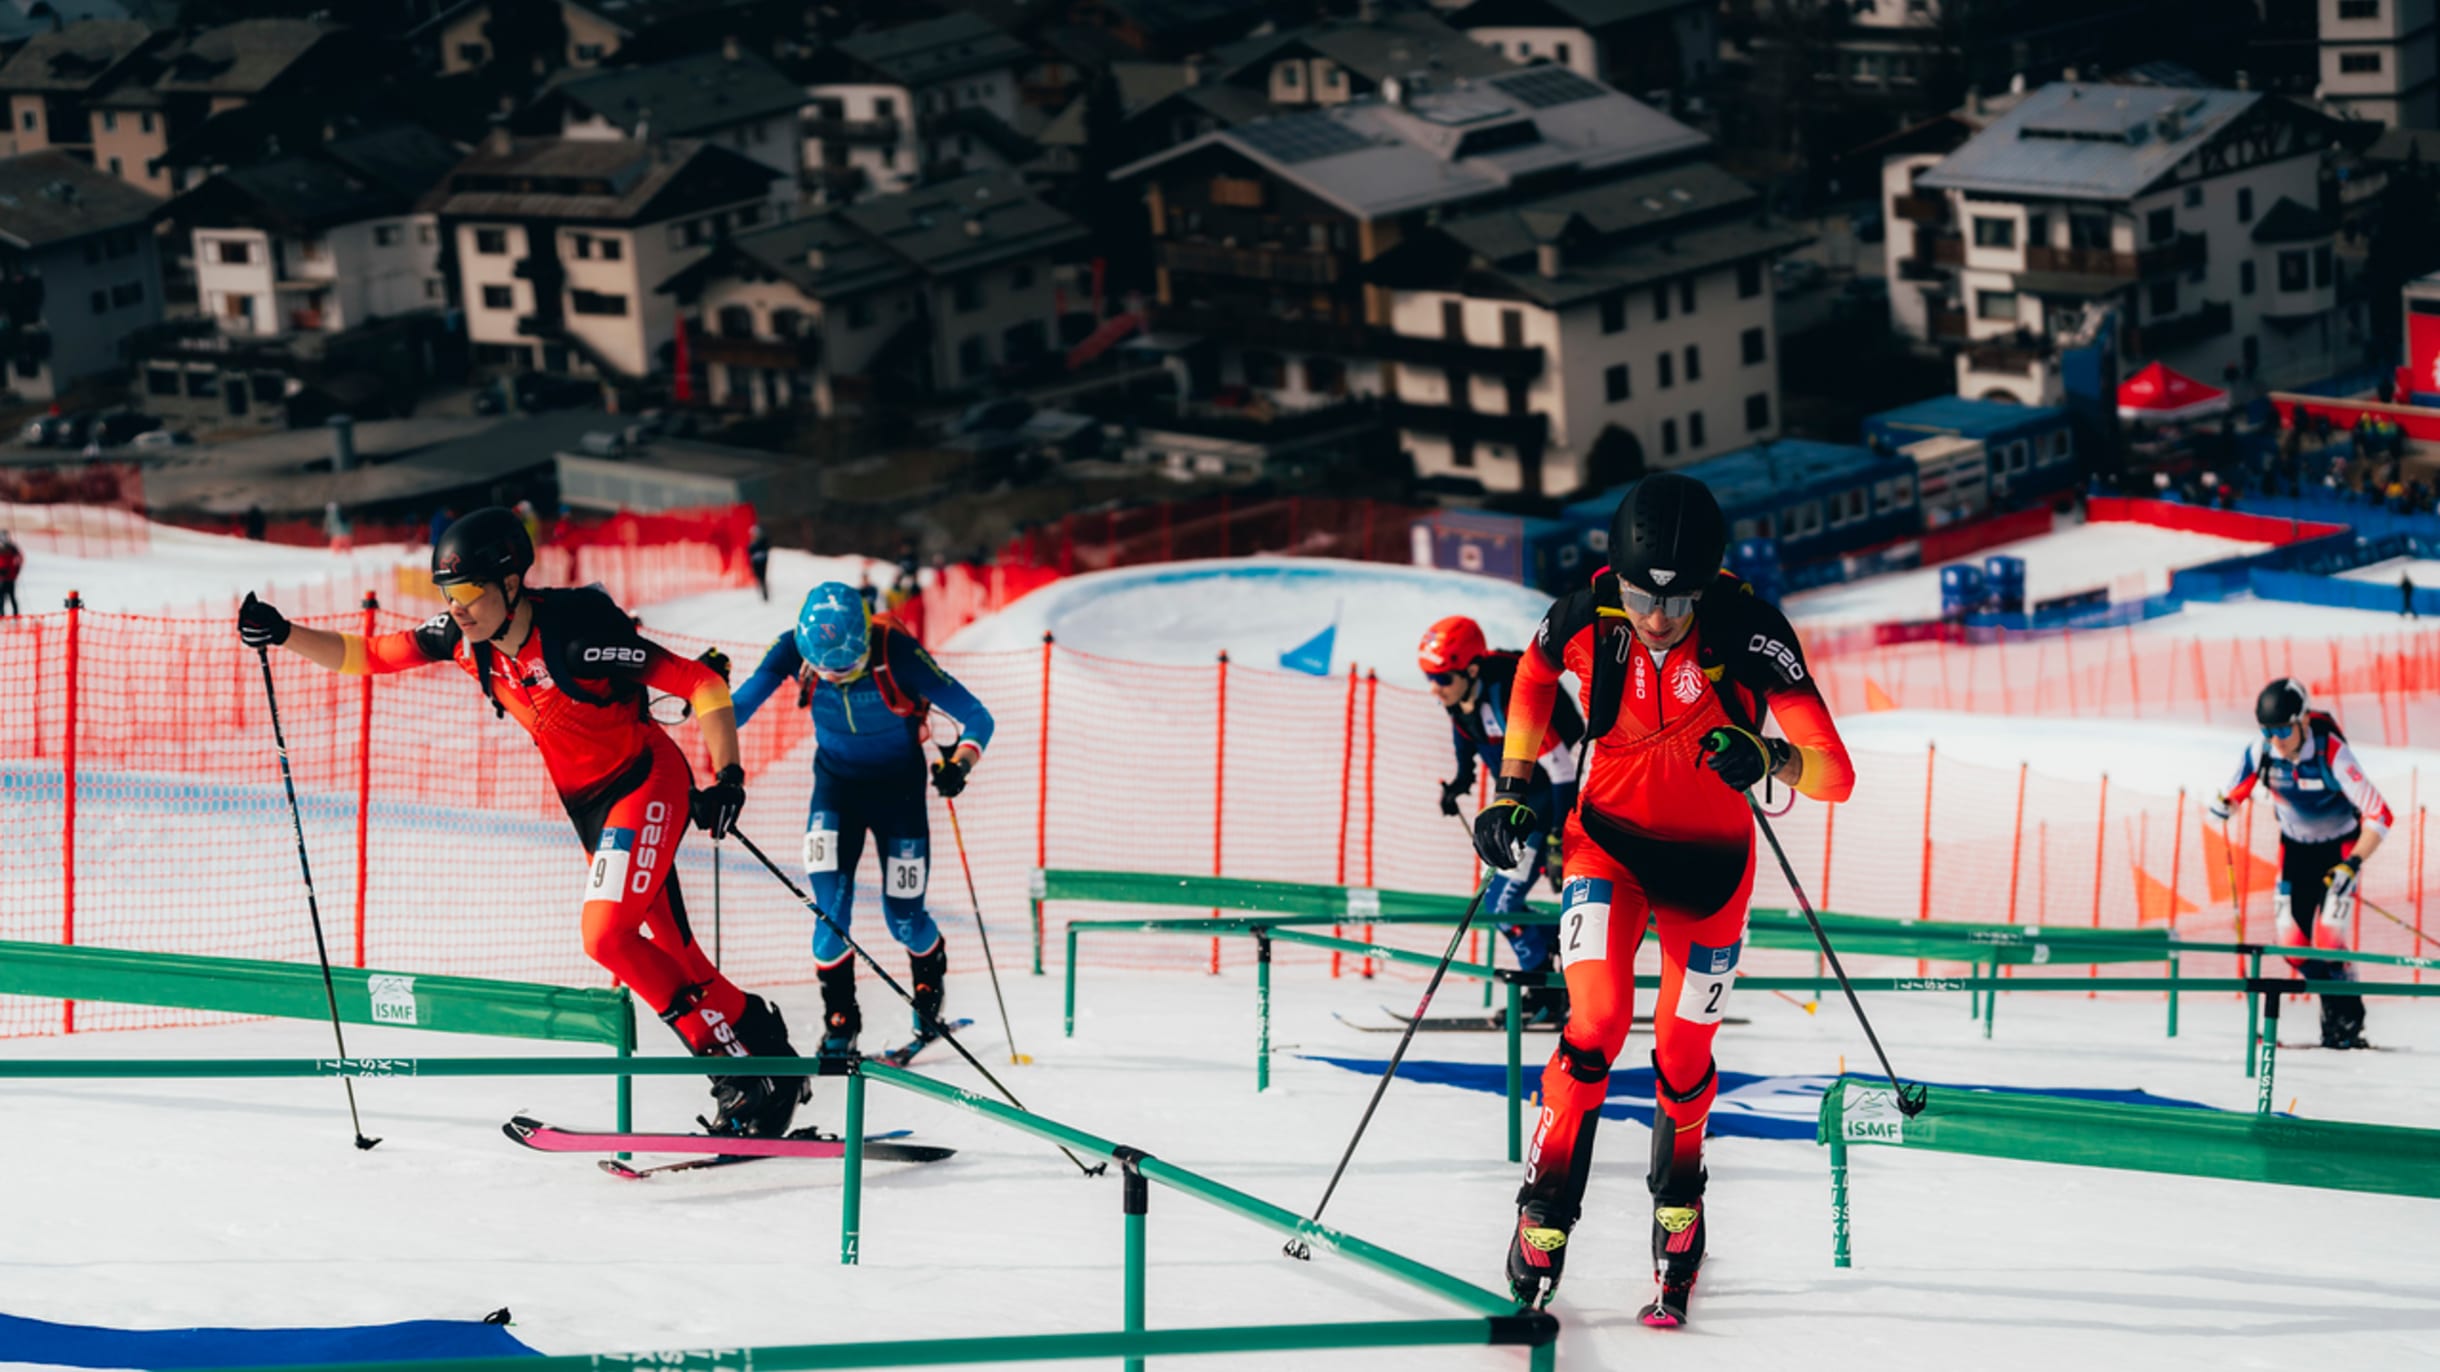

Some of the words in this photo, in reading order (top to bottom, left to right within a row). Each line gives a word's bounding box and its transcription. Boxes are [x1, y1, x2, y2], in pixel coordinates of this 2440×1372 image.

[593, 857, 608, 888] 9
[896, 866, 918, 889] 36
[1569, 913, 1584, 950] 2
[375, 1003, 414, 1020] ISMF
[1704, 982, 1724, 1014] 2
[1847, 1120, 1899, 1138] ISMF
